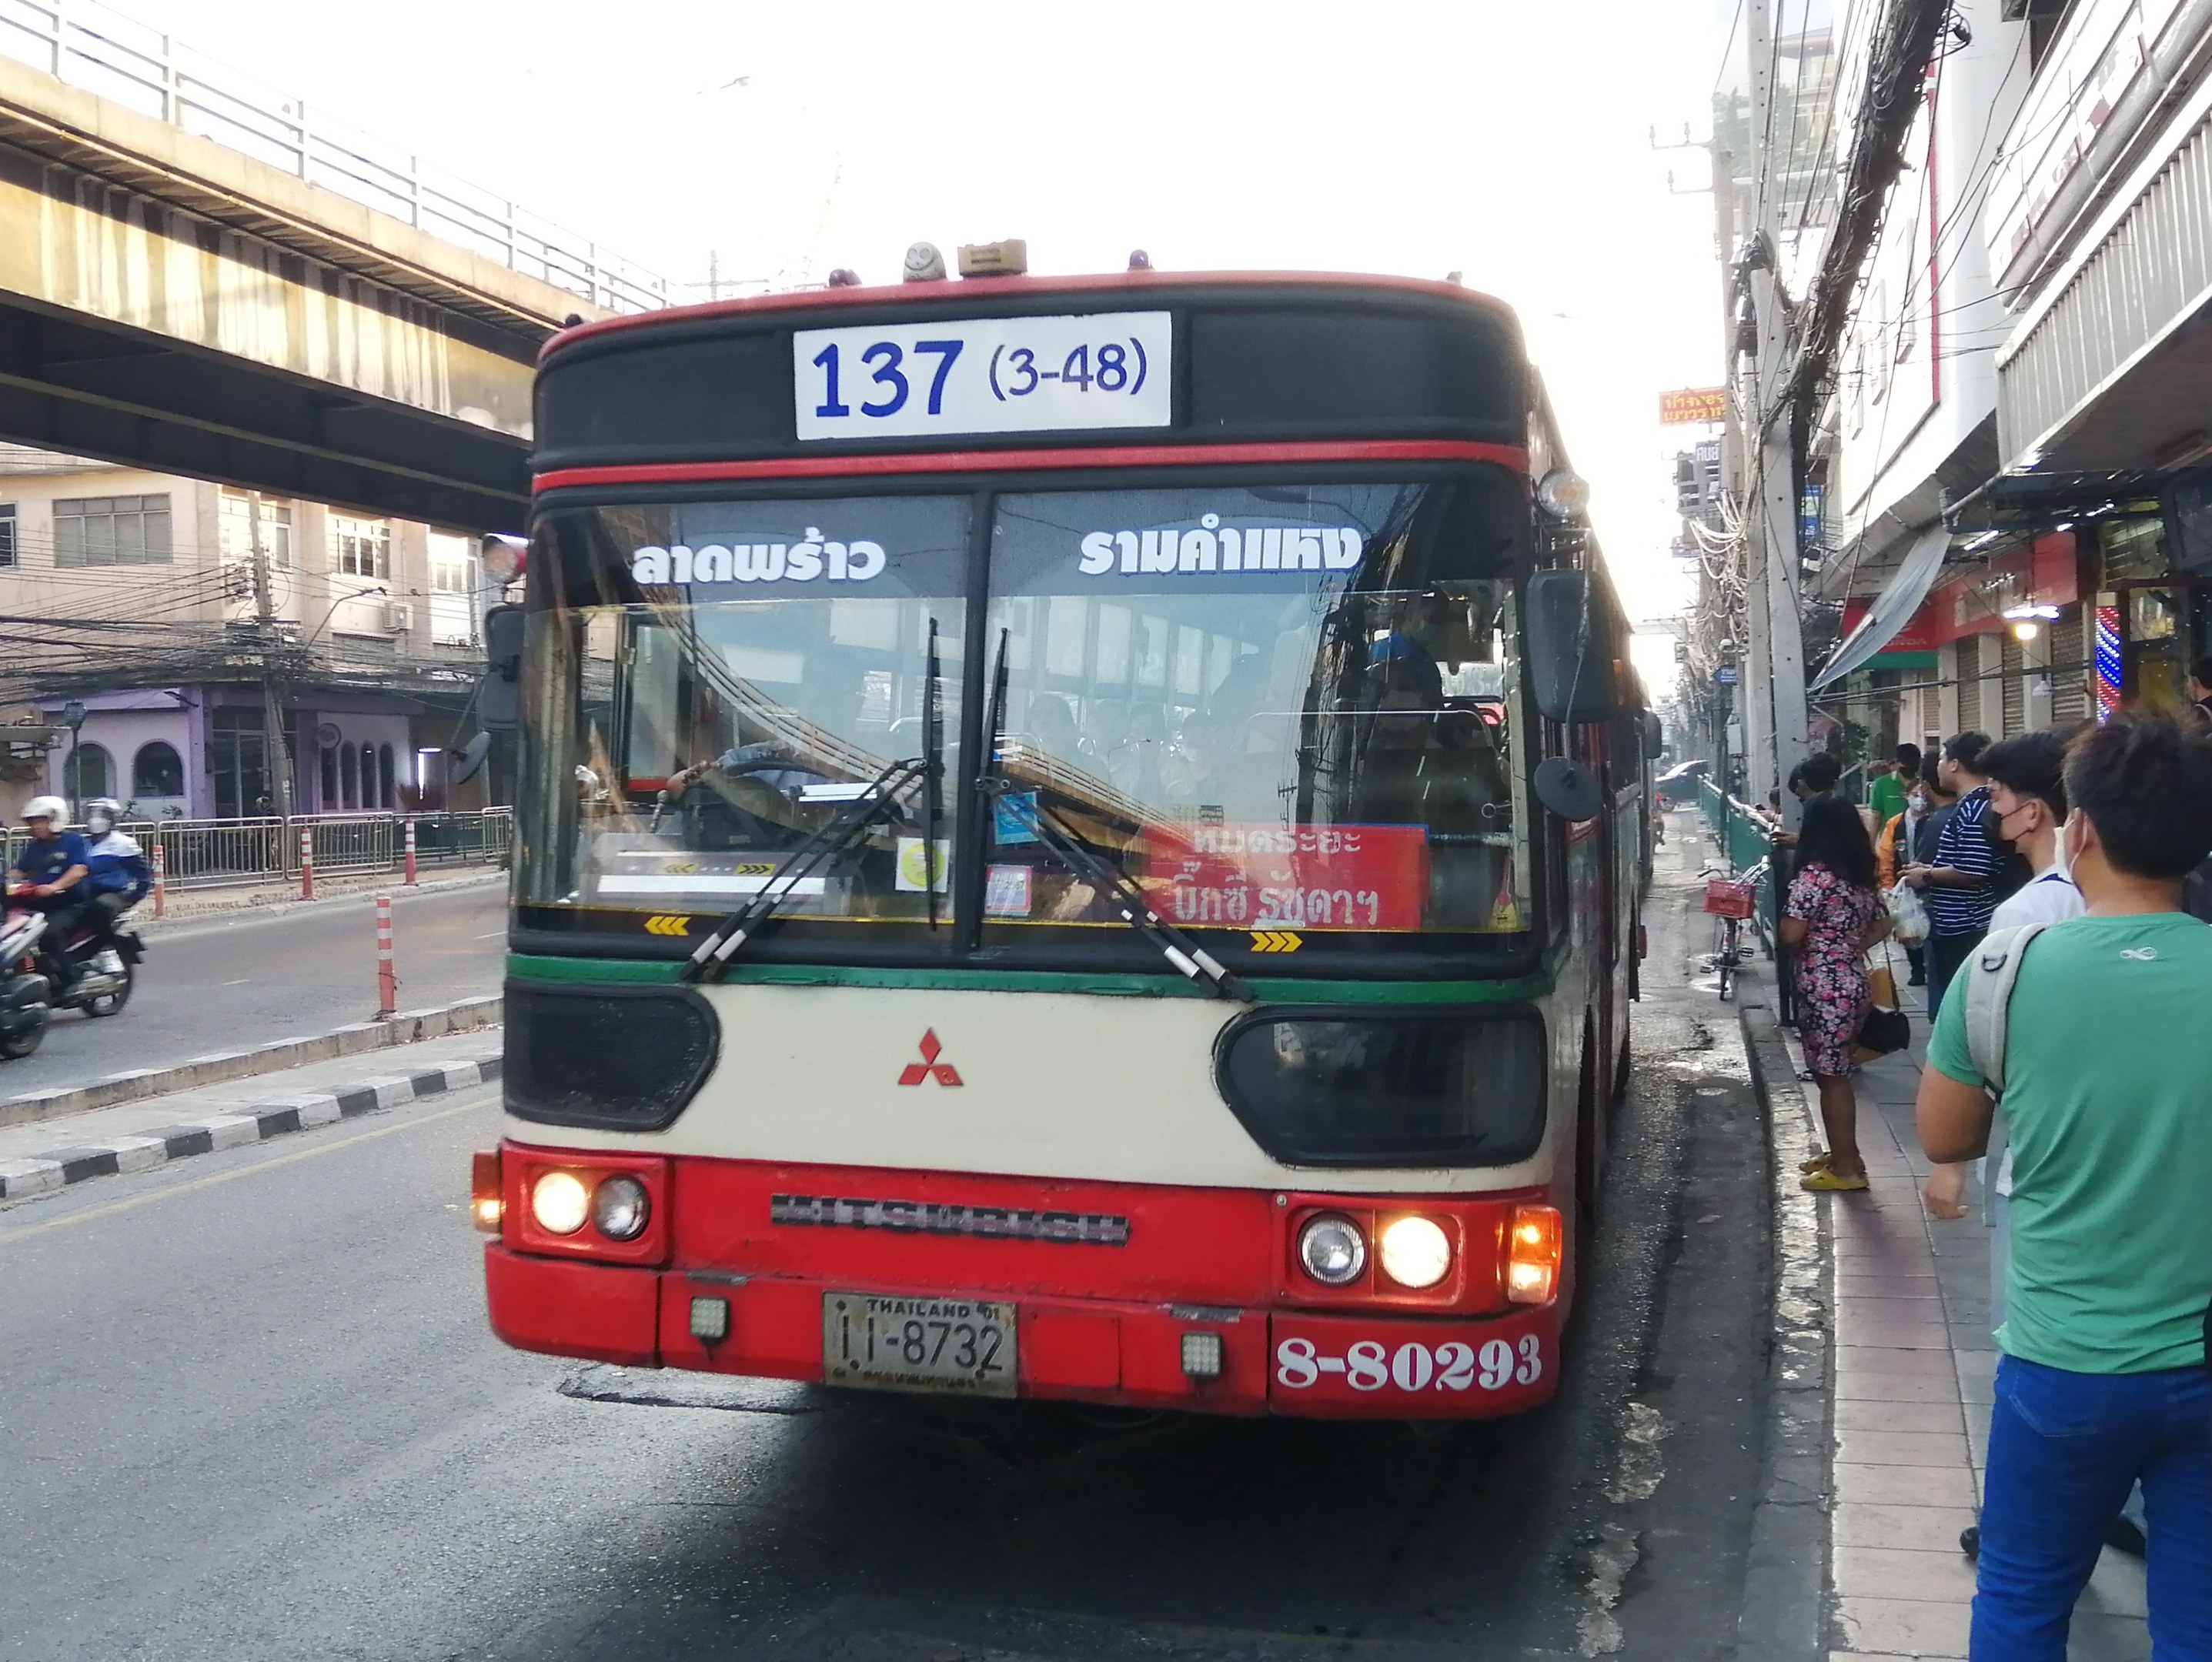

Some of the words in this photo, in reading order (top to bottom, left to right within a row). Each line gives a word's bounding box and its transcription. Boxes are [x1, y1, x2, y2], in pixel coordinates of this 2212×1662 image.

[813, 339, 964, 418] 137
[989, 337, 1148, 402] (3-48)
[631, 526, 887, 585] ลาดพร้าว
[1078, 512, 1364, 576] รามคำแหง
[1193, 829, 1361, 854] หมดระยะ
[1258, 869, 1378, 925] รัชดาฯ
[770, 1193, 1131, 1246] MITSUBISHI
[867, 1299, 970, 1319] THAILAND
[1277, 1333, 1542, 1392] 8-80293
